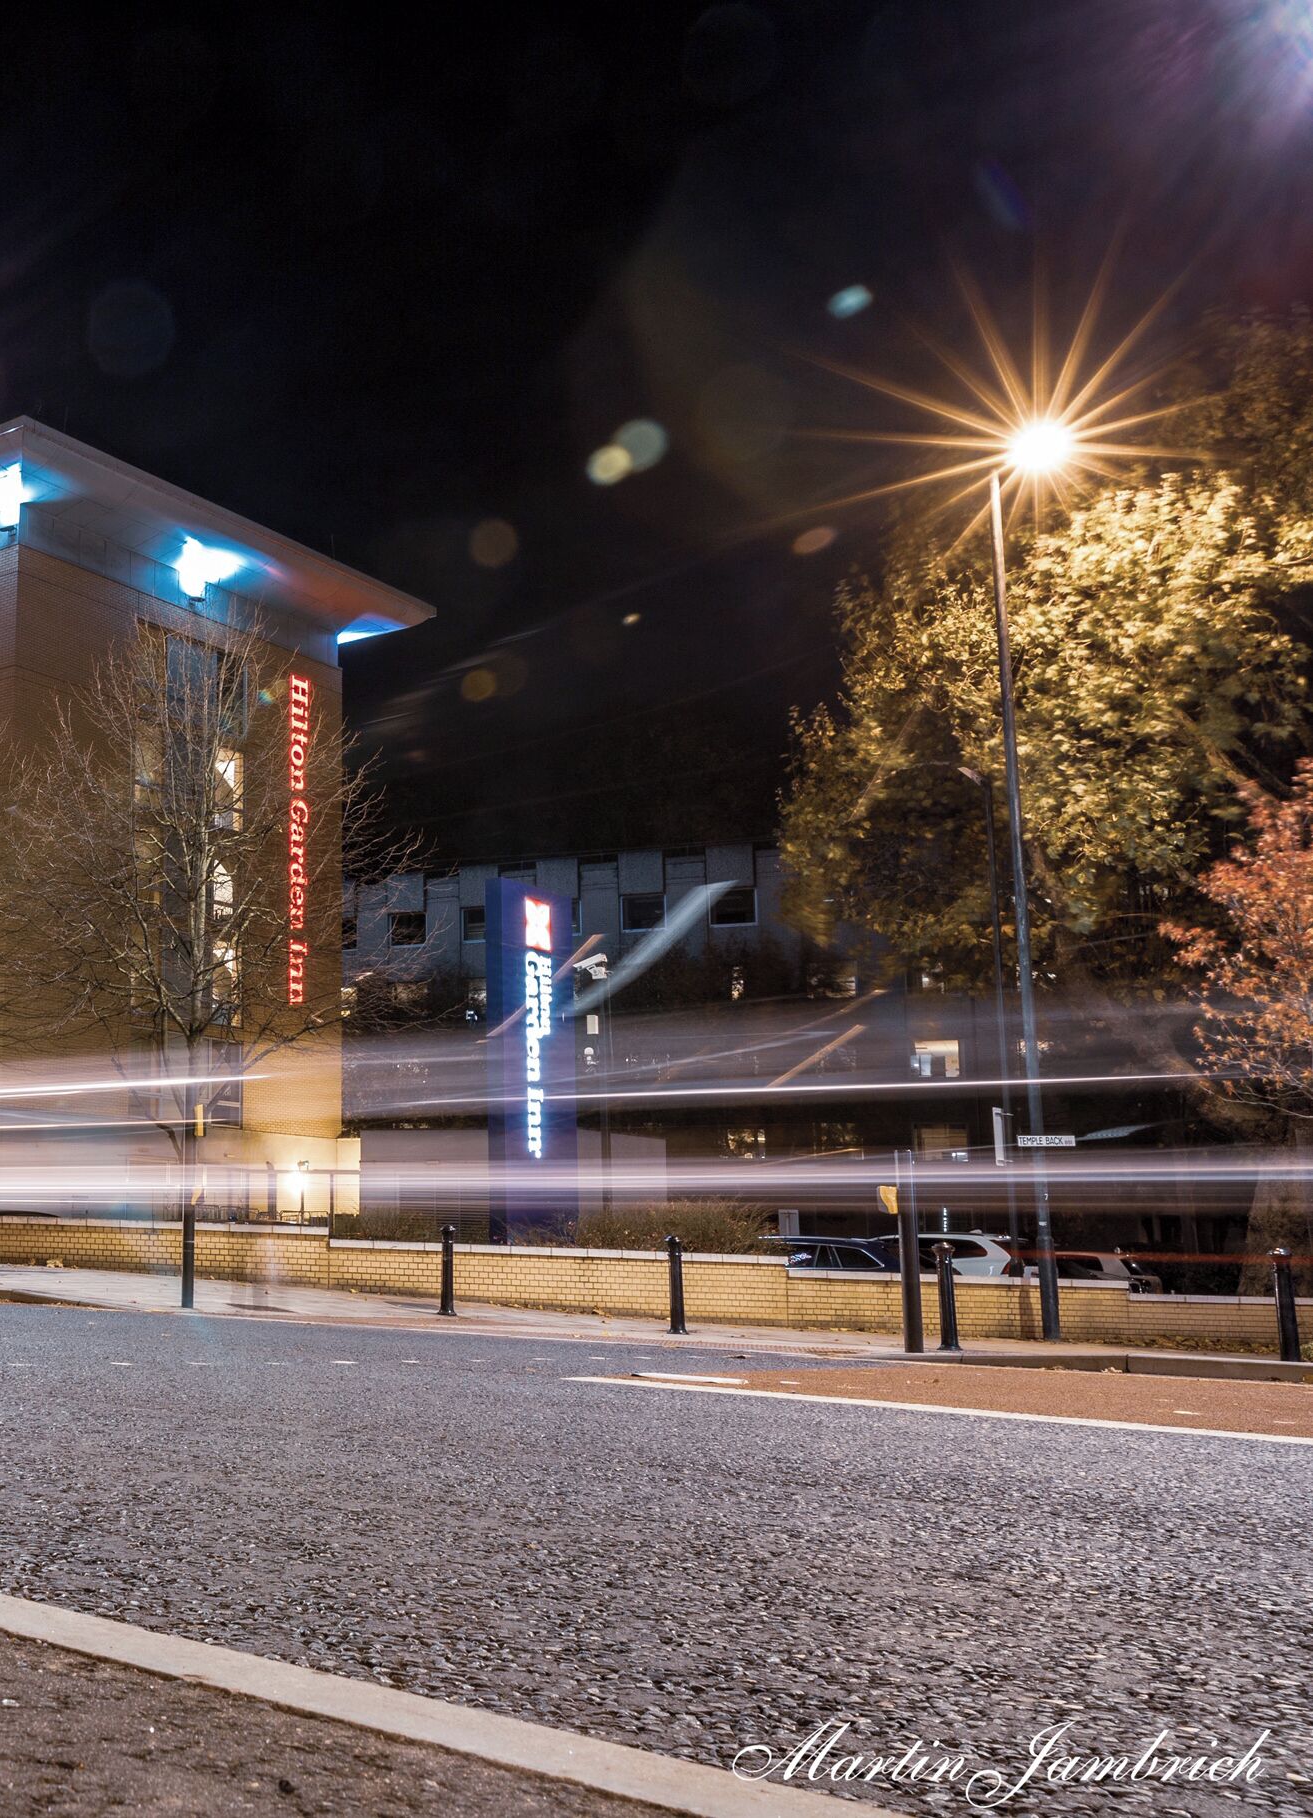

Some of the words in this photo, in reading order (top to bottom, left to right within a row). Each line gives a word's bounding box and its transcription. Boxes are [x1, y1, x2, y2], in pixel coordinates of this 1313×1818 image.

[290, 674, 309, 792] Hilton
[290, 800, 309, 930] Garden
[289, 940, 308, 1005] Inn
[539, 955, 552, 1036] Hilton
[525, 952, 543, 1082] Garden
[527, 1087, 544, 1153] Inn
[1018, 1136, 1043, 1146] TEMPLE
[1045, 1136, 1063, 1146] BACK
